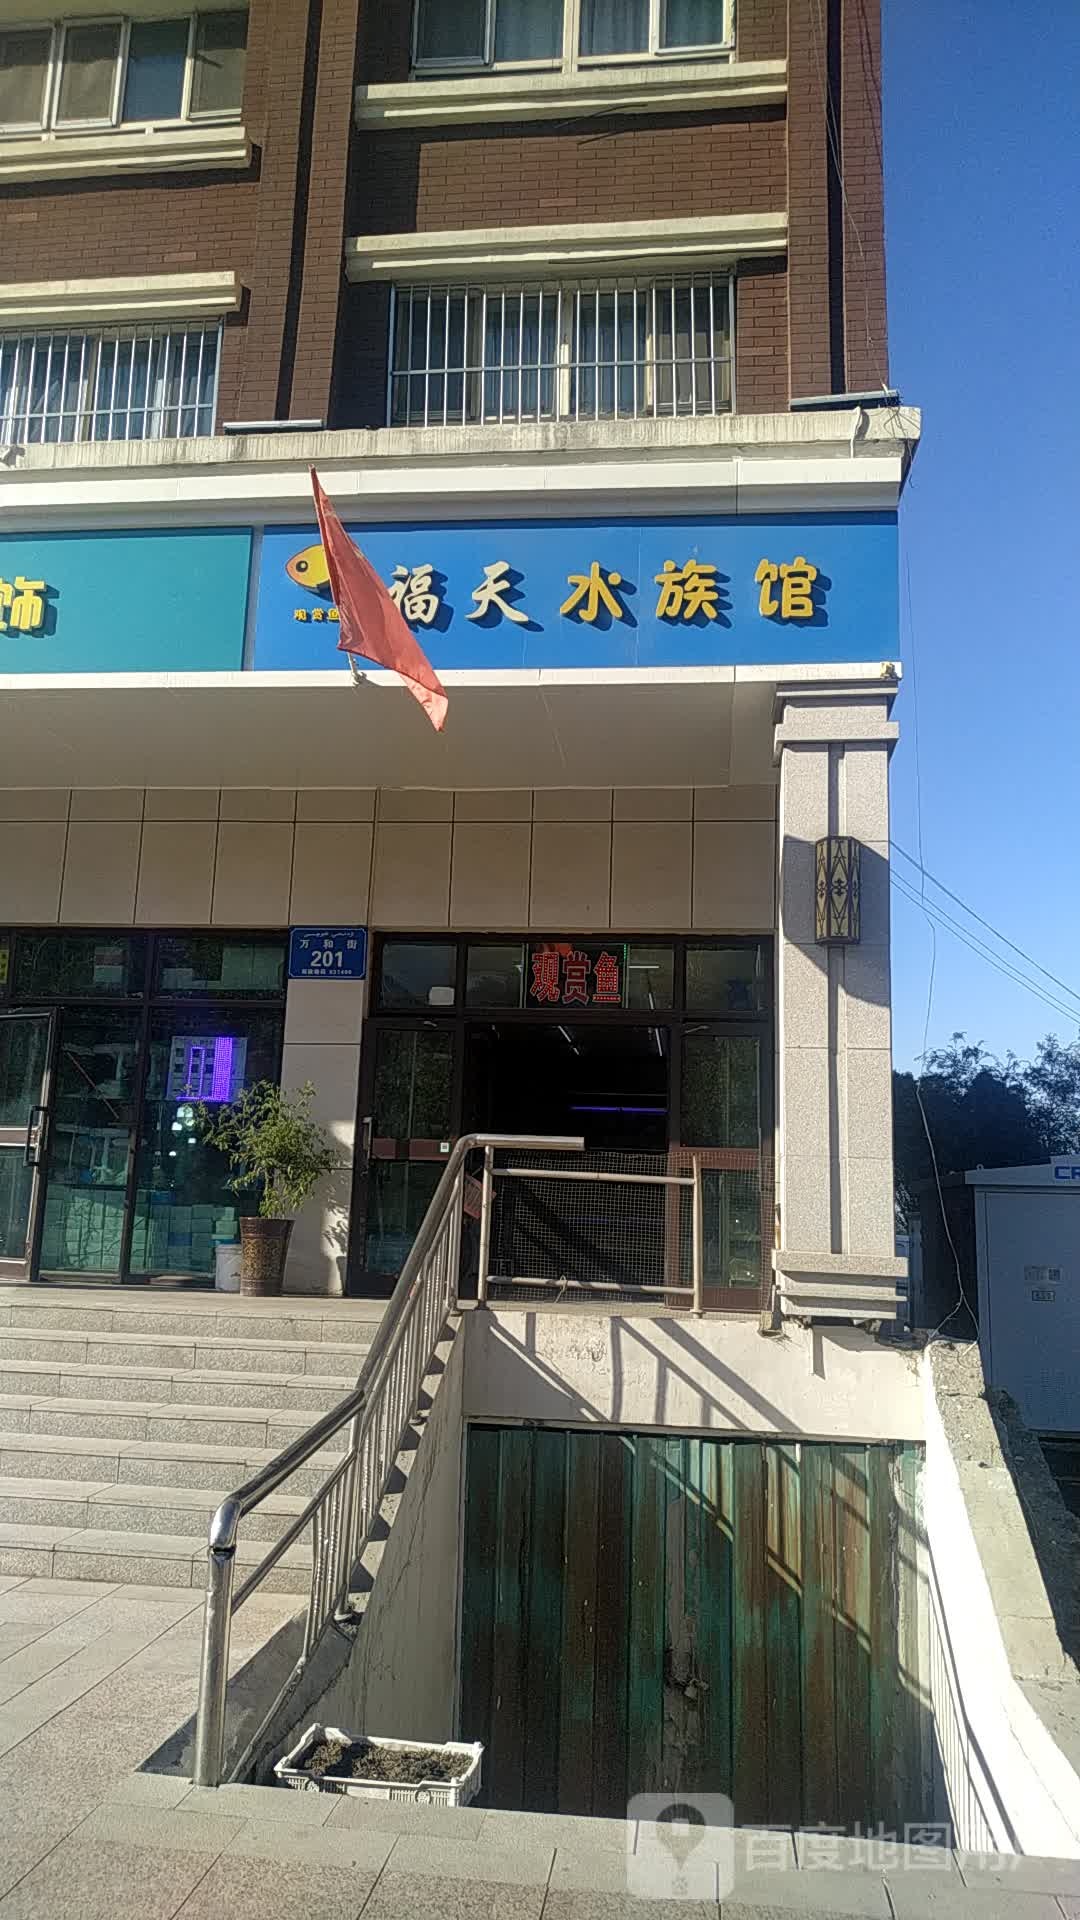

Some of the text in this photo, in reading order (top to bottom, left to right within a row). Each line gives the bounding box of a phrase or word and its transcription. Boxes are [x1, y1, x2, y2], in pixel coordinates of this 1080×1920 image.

[388, 557, 818, 623] 福天水族馆
[310, 950, 343, 967] 201
[530, 951, 621, 1006] 观赏鱼
